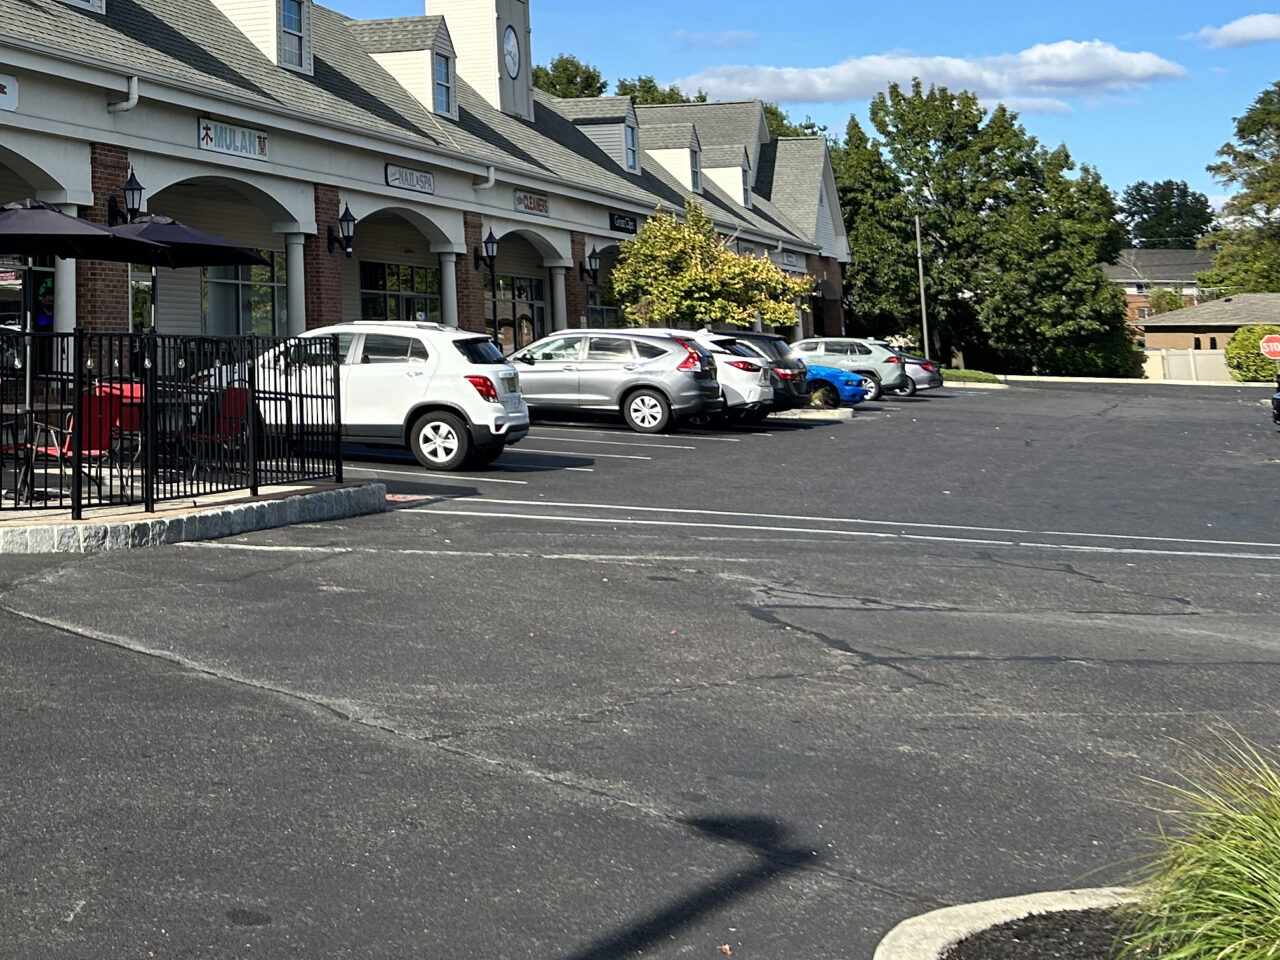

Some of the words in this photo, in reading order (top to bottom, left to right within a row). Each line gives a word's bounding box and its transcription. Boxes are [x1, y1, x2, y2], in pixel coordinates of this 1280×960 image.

[213, 124, 256, 155] MULAN
[399, 170, 416, 187] NAIL
[420, 174, 432, 190] SPA
[523, 194, 548, 213] CLEANERS
